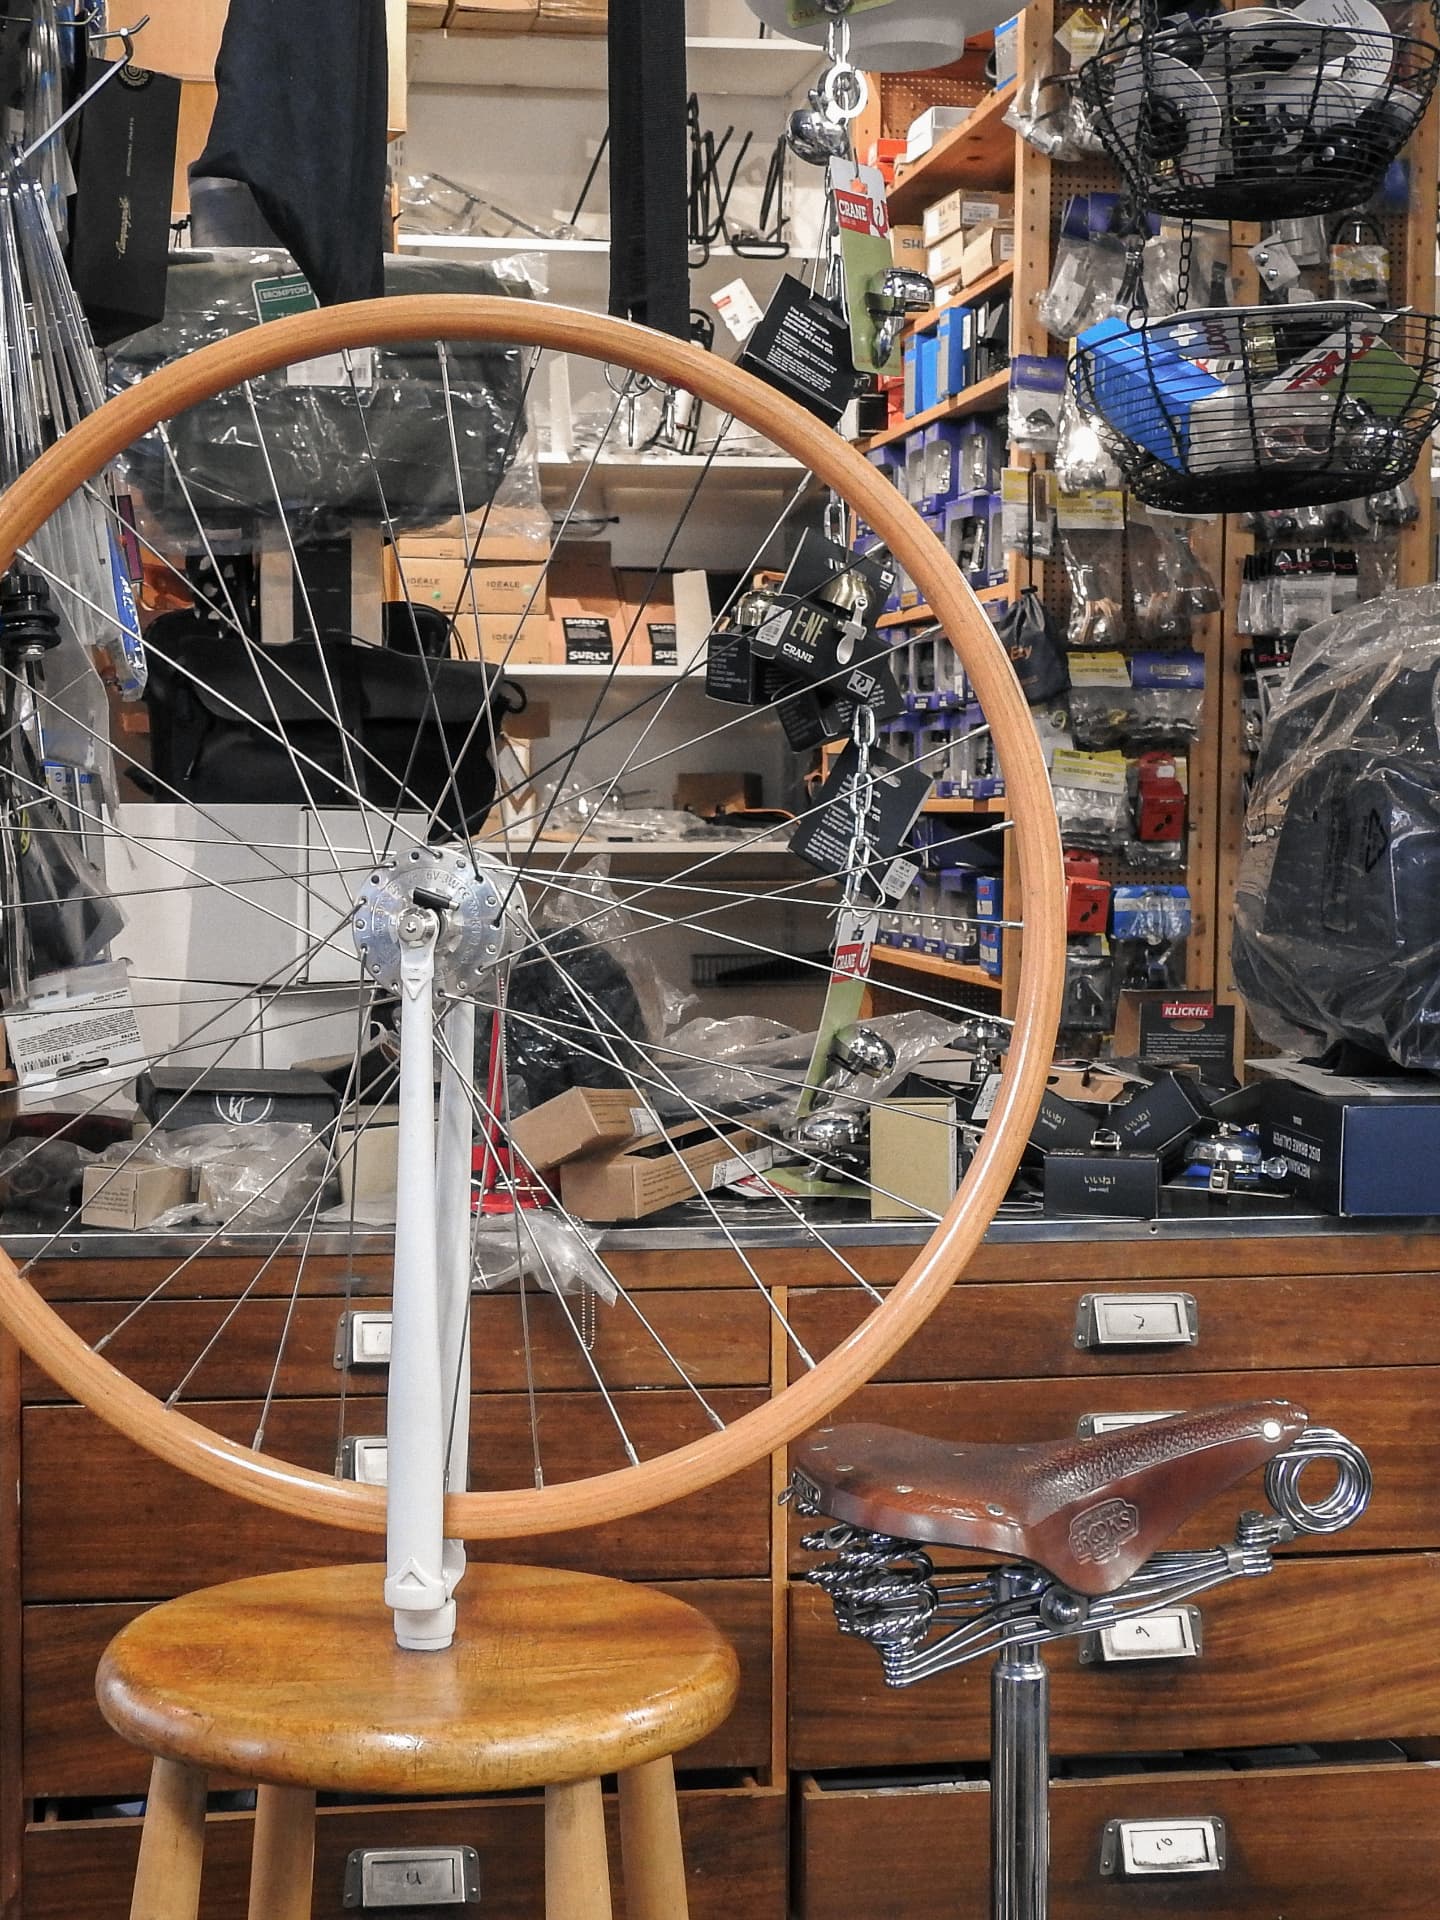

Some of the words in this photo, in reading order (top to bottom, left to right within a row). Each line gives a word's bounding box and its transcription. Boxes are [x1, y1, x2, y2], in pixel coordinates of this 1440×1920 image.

[838, 199, 868, 221] CRANE
[262, 285, 307, 300] BROMPTON
[406, 577, 440, 585] IDEALE
[486, 580, 520, 588] IDEALE
[568, 650, 611, 661] SURLY
[782, 642, 815, 664] CRANE
[835, 953, 857, 970] CRANE
[1164, 1006, 1209, 1017] KLICKfix
[1071, 1510, 1132, 1556] BROOKS
